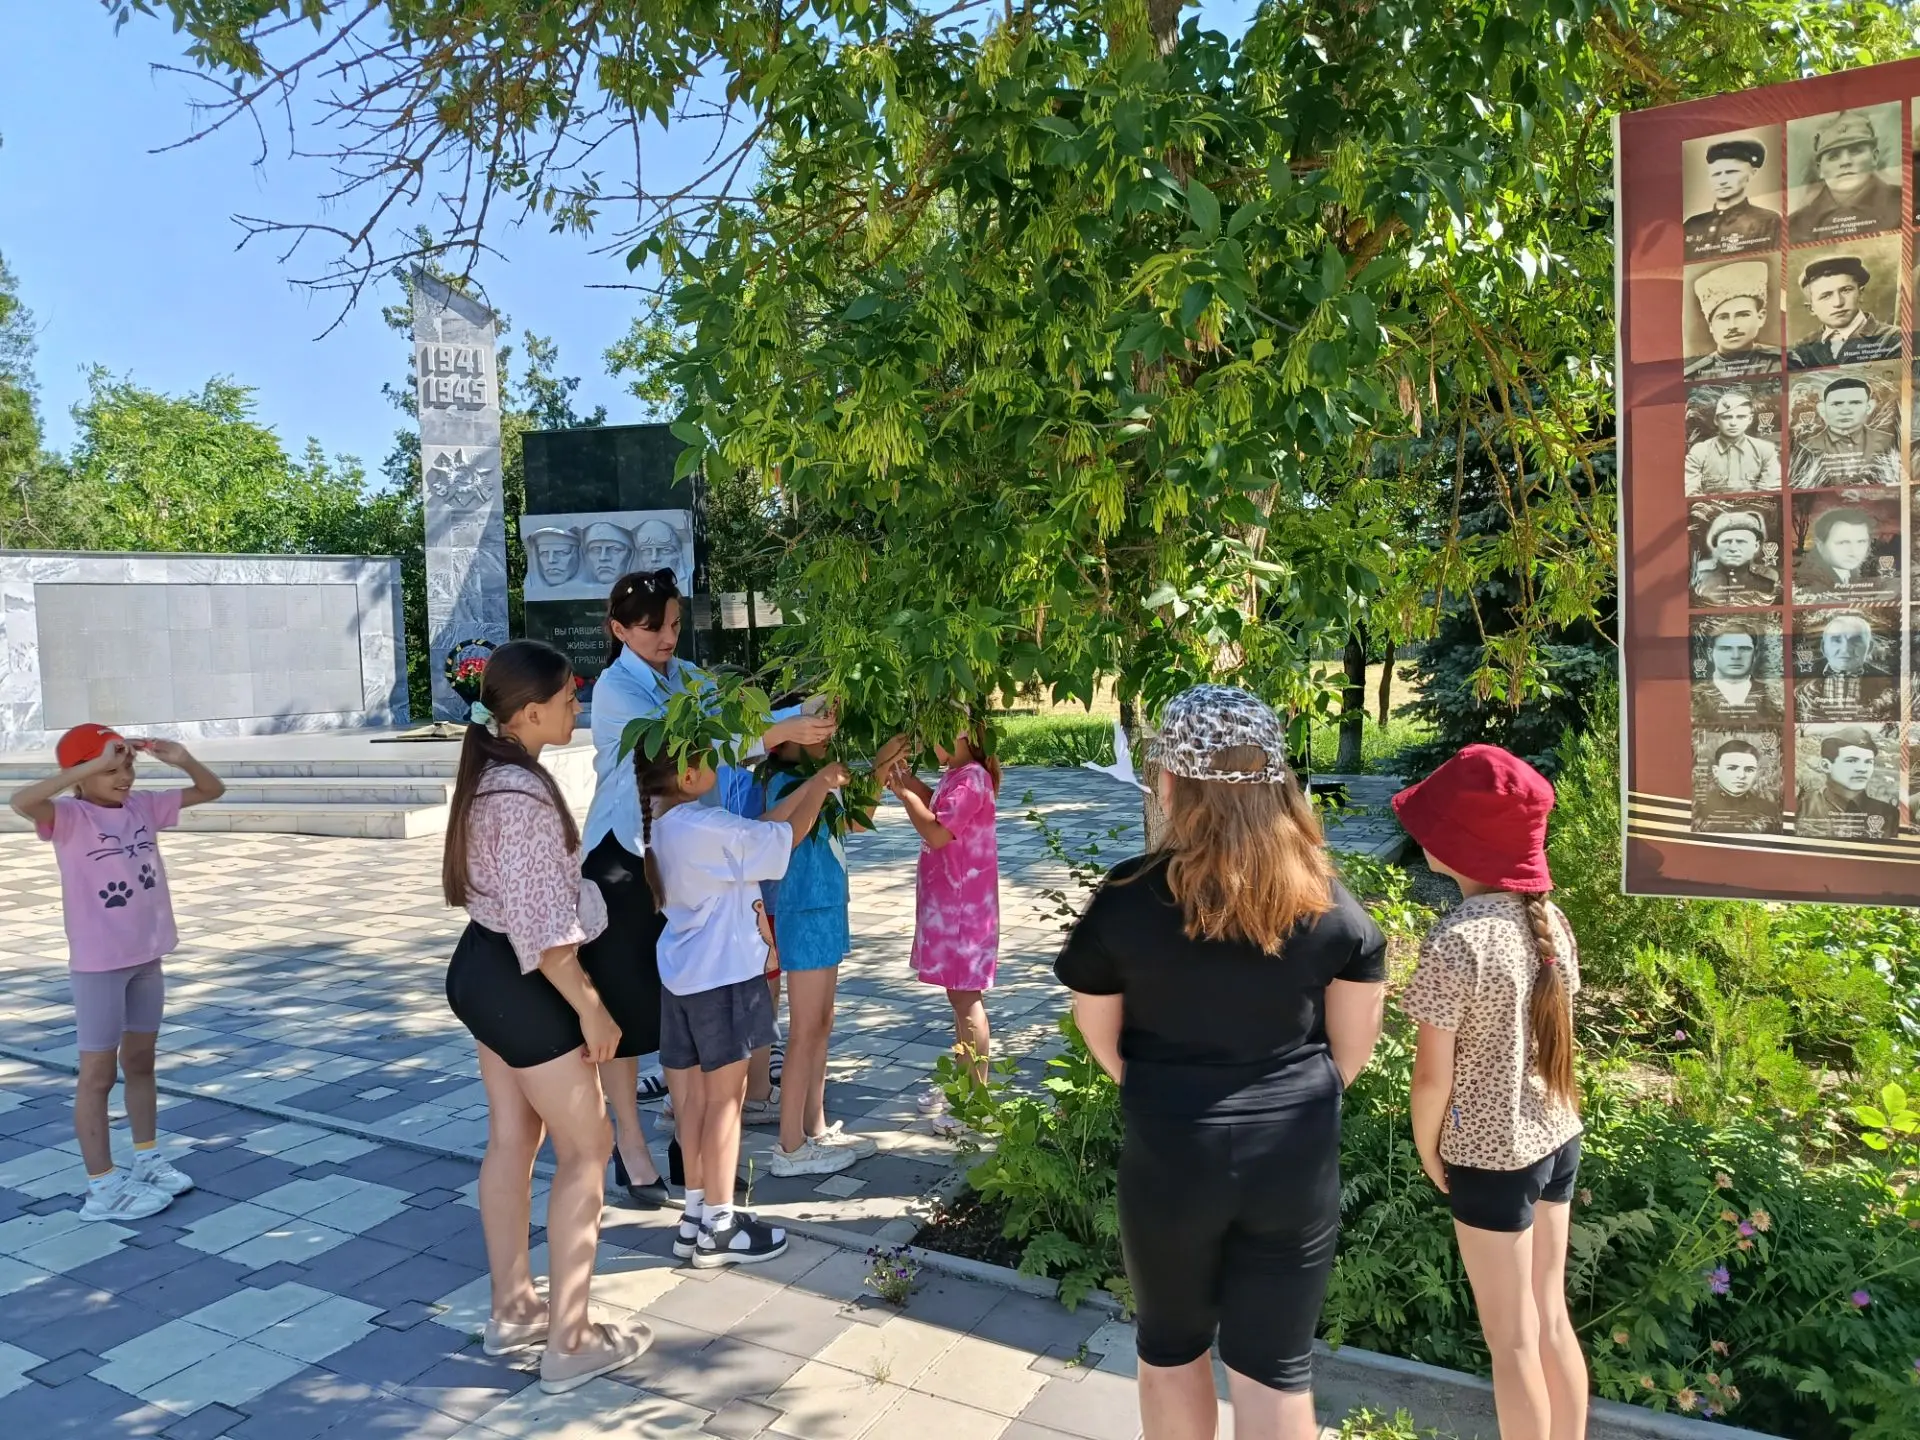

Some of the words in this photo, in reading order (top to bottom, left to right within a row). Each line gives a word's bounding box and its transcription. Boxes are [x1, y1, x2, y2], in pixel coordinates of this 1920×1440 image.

[424, 346, 485, 375] 1941
[426, 378, 487, 404] 1945
[554, 627, 567, 636] ВЫ
[568, 626, 602, 635] ПАВШИЕ
[567, 640, 597, 650] ЖИВЫЕ
[598, 640, 604, 649] В
[574, 655, 608, 665] ГРЯДУЩ
